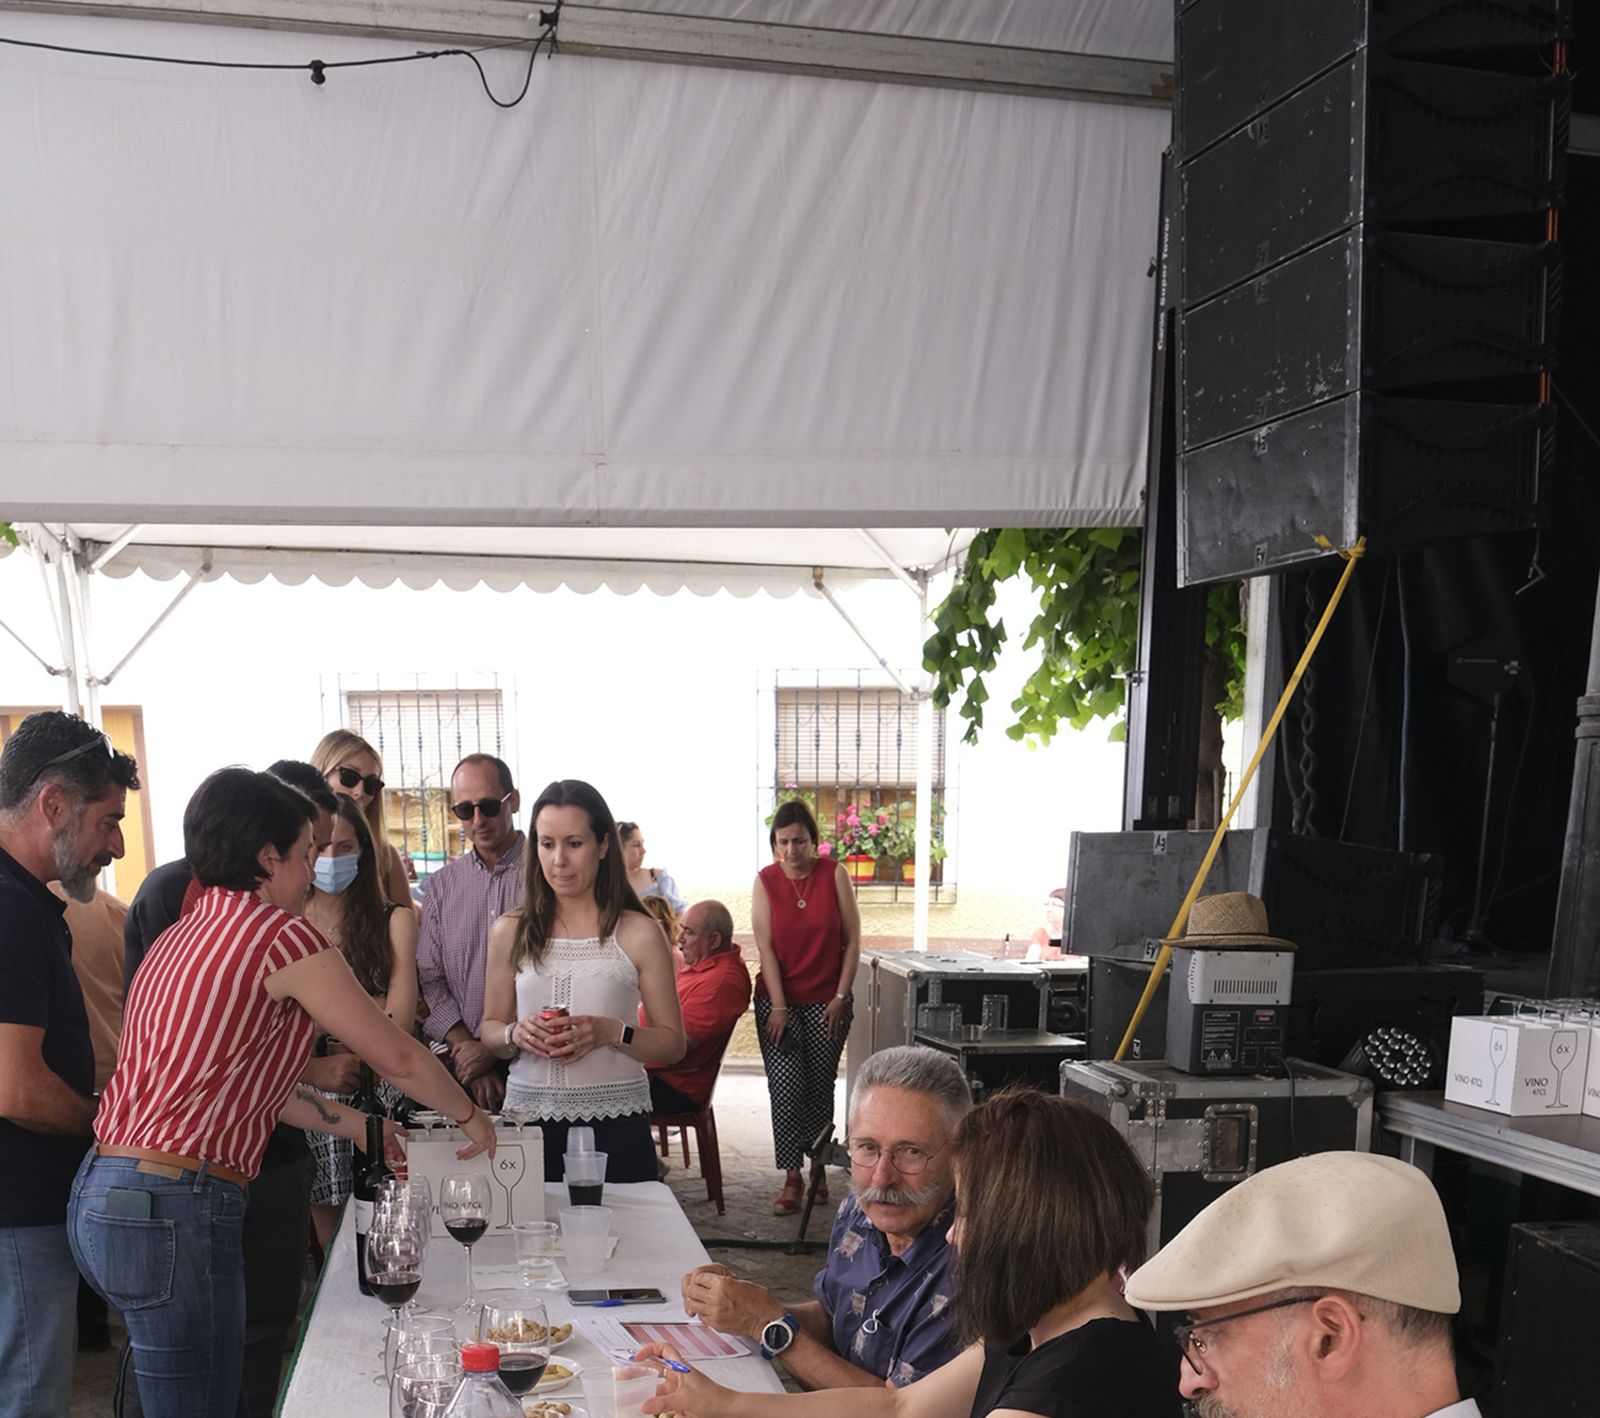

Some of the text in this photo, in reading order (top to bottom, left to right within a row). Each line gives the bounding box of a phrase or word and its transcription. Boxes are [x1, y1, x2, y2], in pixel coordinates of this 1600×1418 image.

[1162, 217, 1170, 260] Tower
[1556, 1043, 1570, 1054] 6x
[1524, 1077, 1549, 1087] VINO
[499, 1158, 517, 1171] 6x
